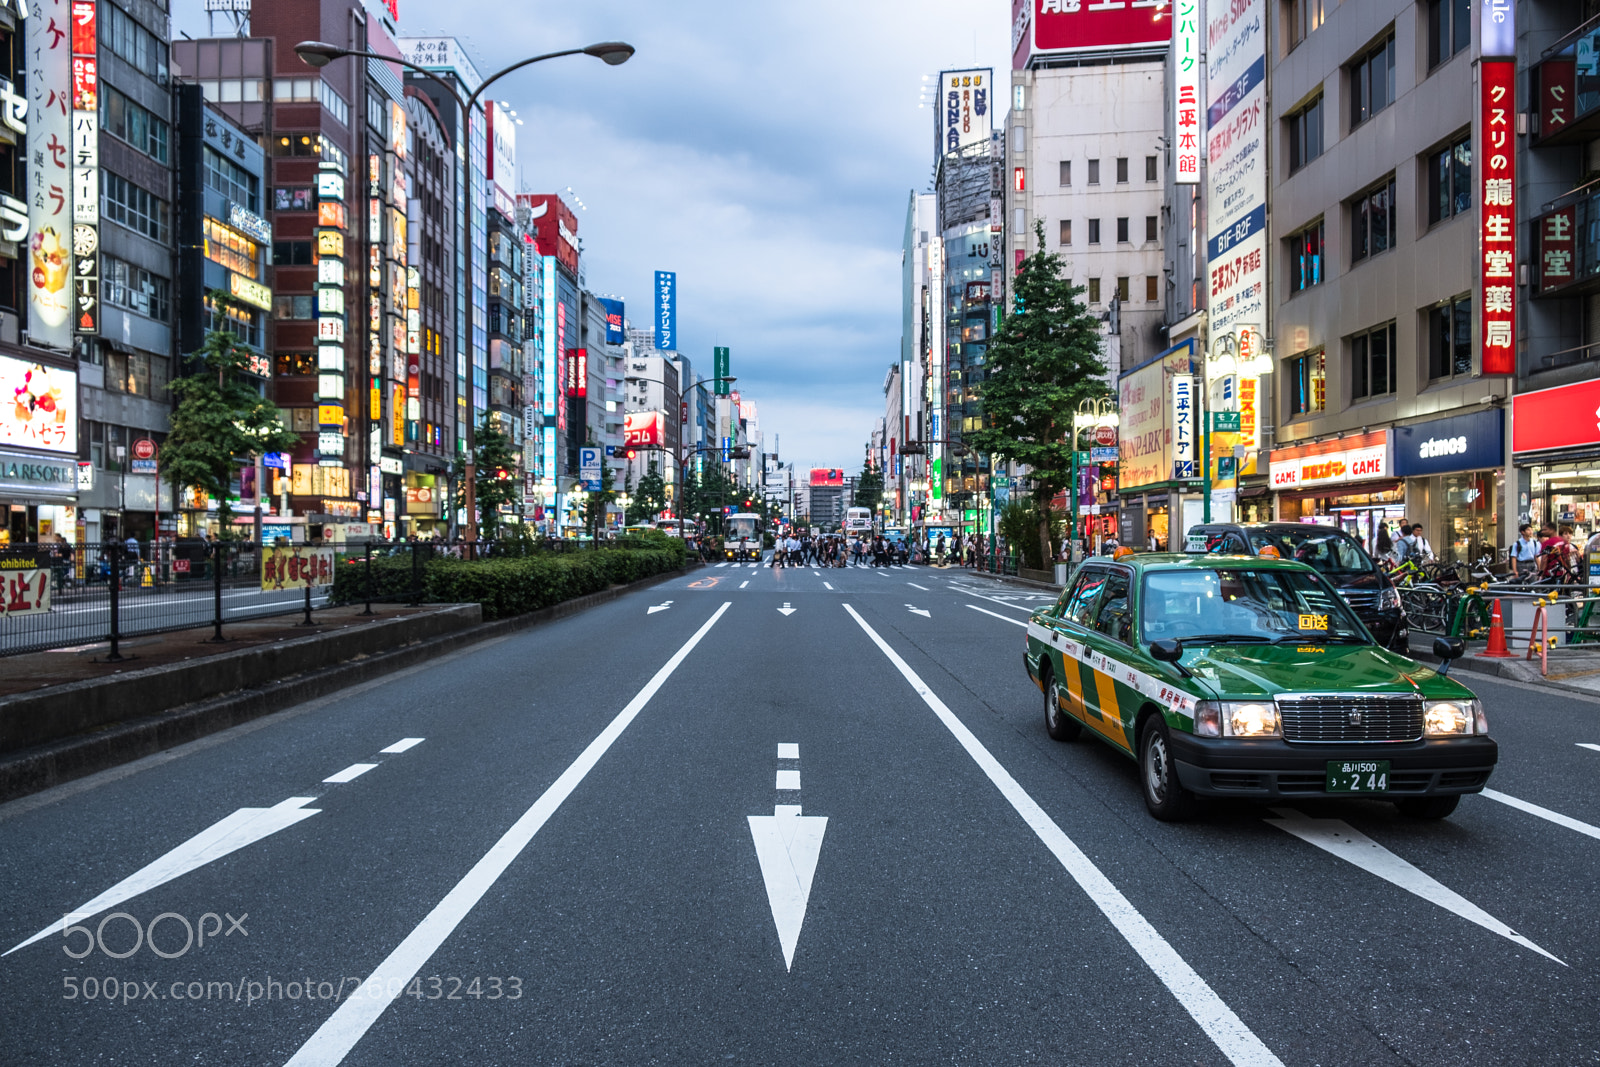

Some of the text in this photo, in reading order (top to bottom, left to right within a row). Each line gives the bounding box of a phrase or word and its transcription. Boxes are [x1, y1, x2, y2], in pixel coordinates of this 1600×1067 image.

[416, 41, 448, 52] 水の森
[973, 88, 987, 116] NEW
[1179, 86, 1197, 173] 三平本館
[77, 118, 93, 198] パーティー
[1484, 84, 1513, 348] クスリの龍生堂薬局
[660, 285, 671, 349] オザキクリニック
[1177, 382, 1190, 454] 三平ストア
[1119, 428, 1162, 460] SUNPARK
[1420, 436, 1467, 458] atmos
[583, 450, 595, 466] P
[1352, 459, 1381, 475] GAME
[1275, 470, 1296, 484] GAME
[0, 558, 38, 569] ohibited.
[1298, 615, 1328, 631] 回送
[1341, 762, 1377, 773] 品川500
